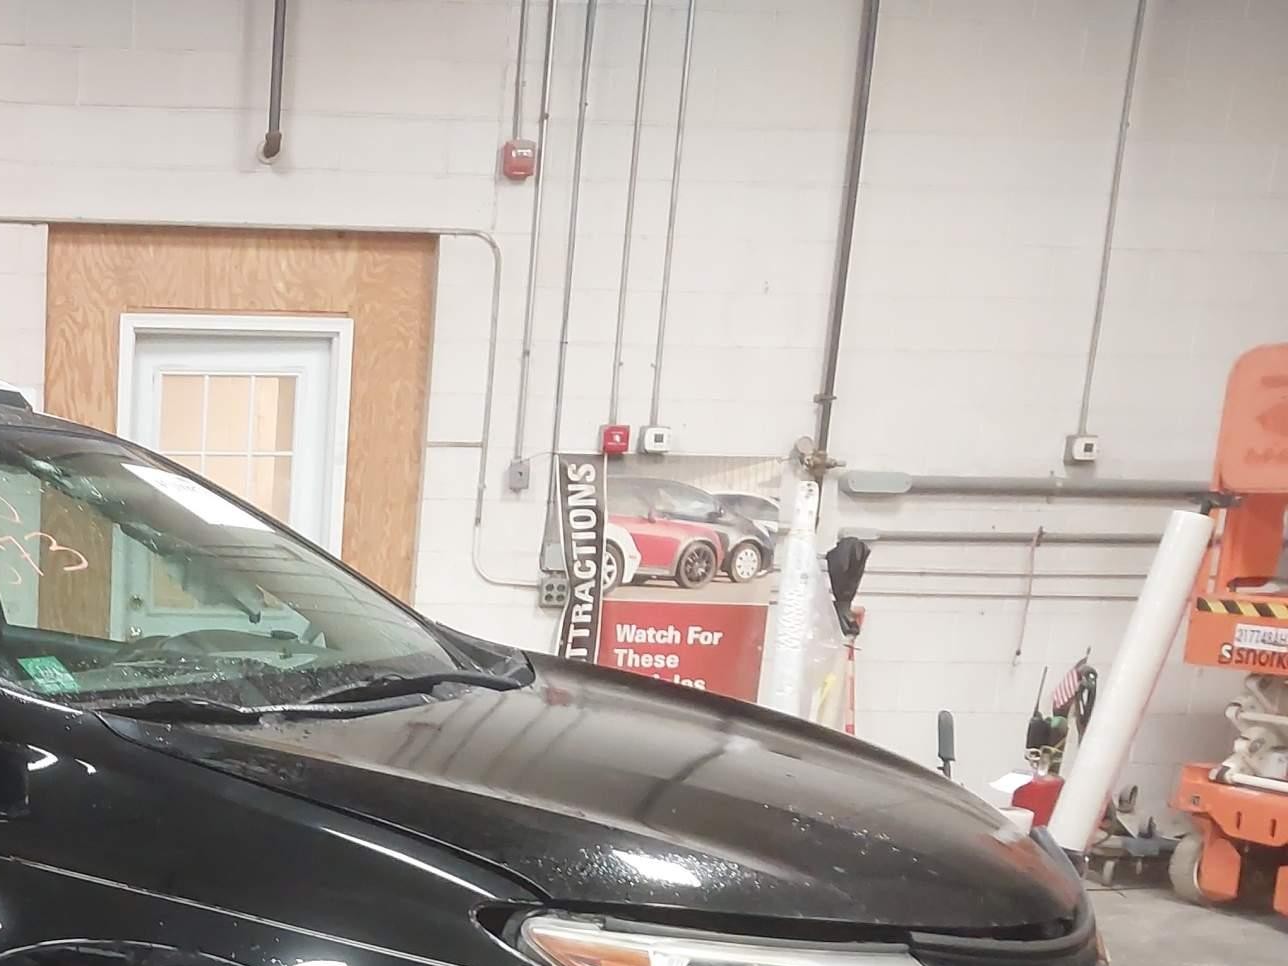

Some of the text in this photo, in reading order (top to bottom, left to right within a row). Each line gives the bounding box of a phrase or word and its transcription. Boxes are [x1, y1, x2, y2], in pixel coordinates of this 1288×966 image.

[565, 463, 597, 662] TTRACTIONS
[615, 623, 723, 645] Watch For
[614, 648, 680, 669] These
